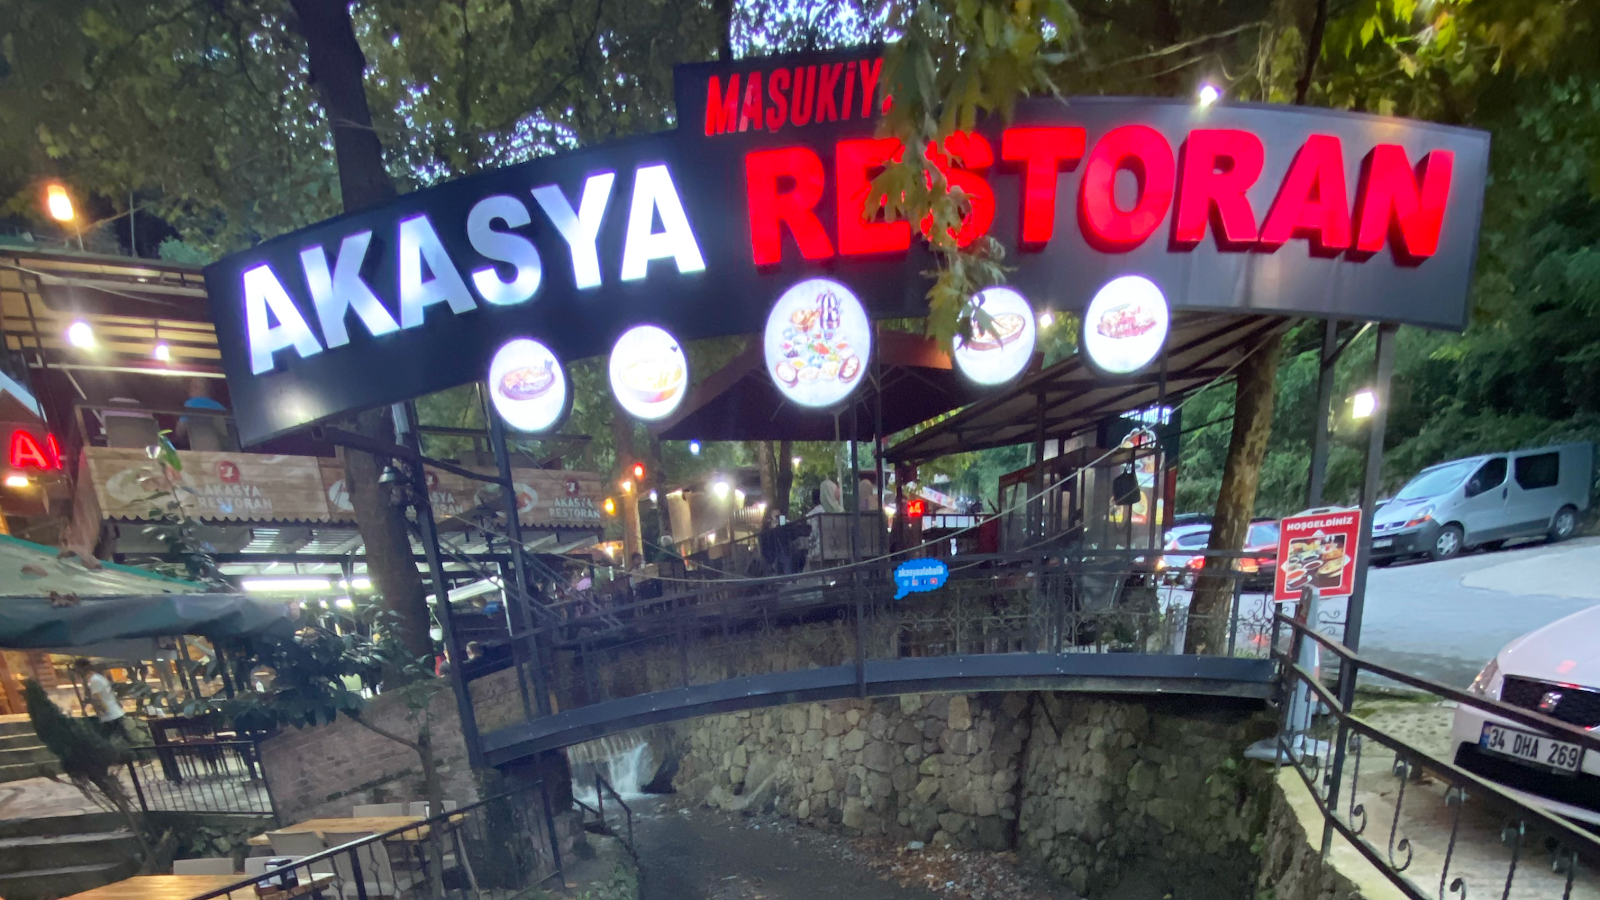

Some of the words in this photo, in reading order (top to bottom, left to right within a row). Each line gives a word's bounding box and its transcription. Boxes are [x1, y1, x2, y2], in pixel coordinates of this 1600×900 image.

[242, 163, 706, 376] AKASYA
[745, 124, 1456, 271] RESTORAN
[205, 484, 261, 497] AKASYA
[198, 496, 273, 510] RESTORAN
[554, 497, 594, 508] AKASYA
[549, 507, 600, 518] RESTORAN
[1489, 729, 1505, 750] 34
[1512, 734, 1539, 759] DHA
[1547, 743, 1579, 769] 269
